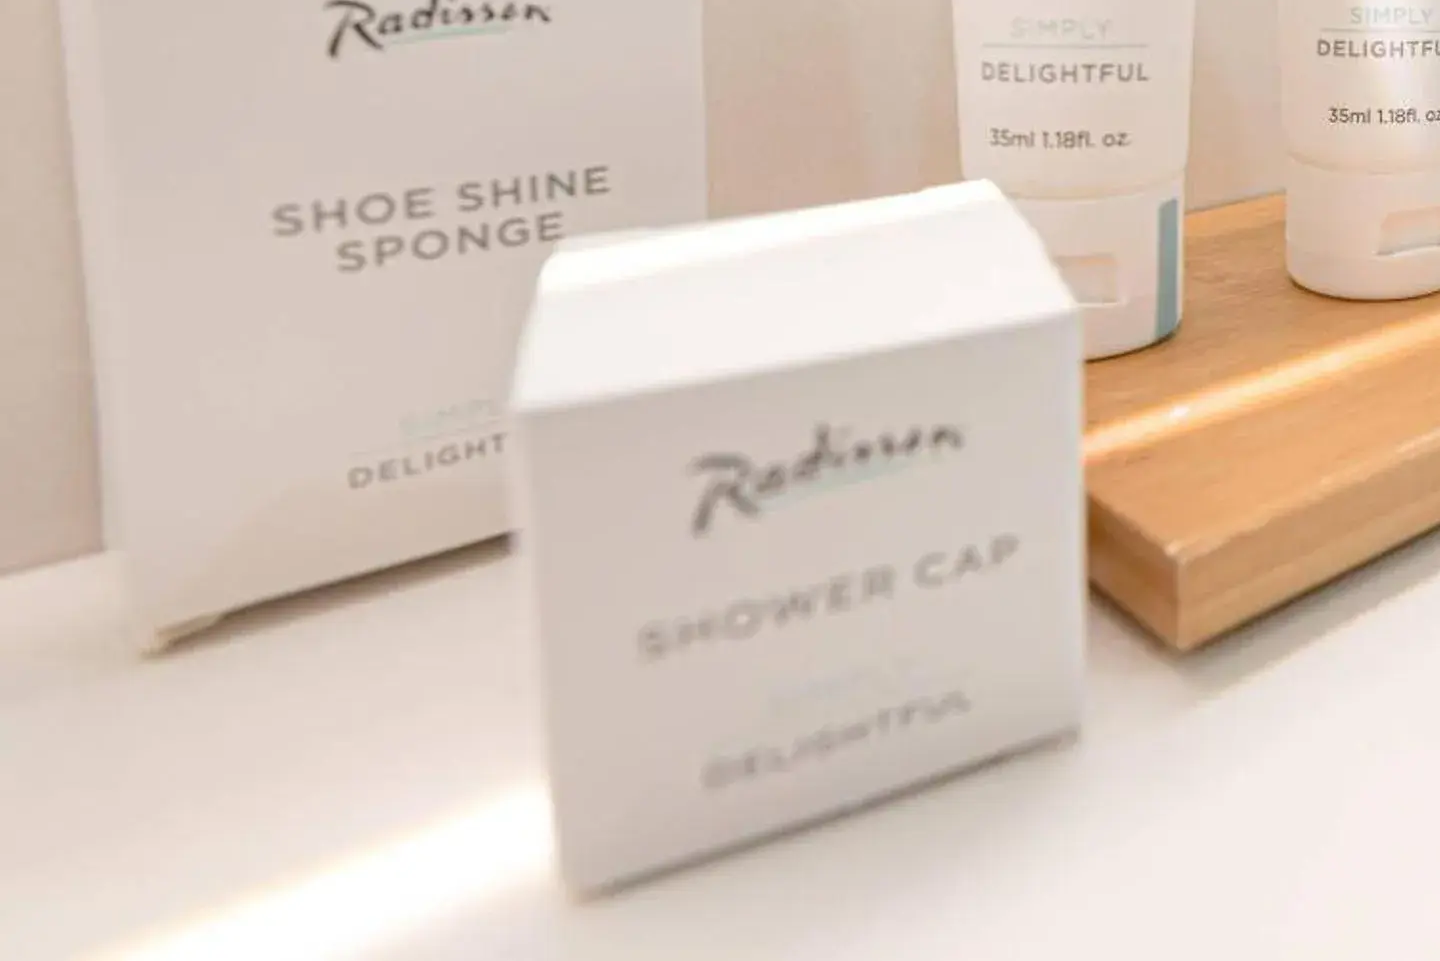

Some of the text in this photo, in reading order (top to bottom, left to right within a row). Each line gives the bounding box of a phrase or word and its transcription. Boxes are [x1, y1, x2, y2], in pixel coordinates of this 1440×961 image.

[1010, 17, 1114, 42] SIMPLY
[1349, 6, 1435, 25] SIMPLY
[982, 62, 1149, 84] DELIGHTFUL
[1328, 107, 1371, 125] 35ml
[990, 128, 1036, 148] 35ml
[270, 164, 613, 237] SHOE SHINE
[335, 211, 565, 274] SPONGE
[346, 432, 508, 490] DELIGHT
[686, 422, 966, 538] Radisson
[637, 534, 1021, 666] SHOWER CAP
